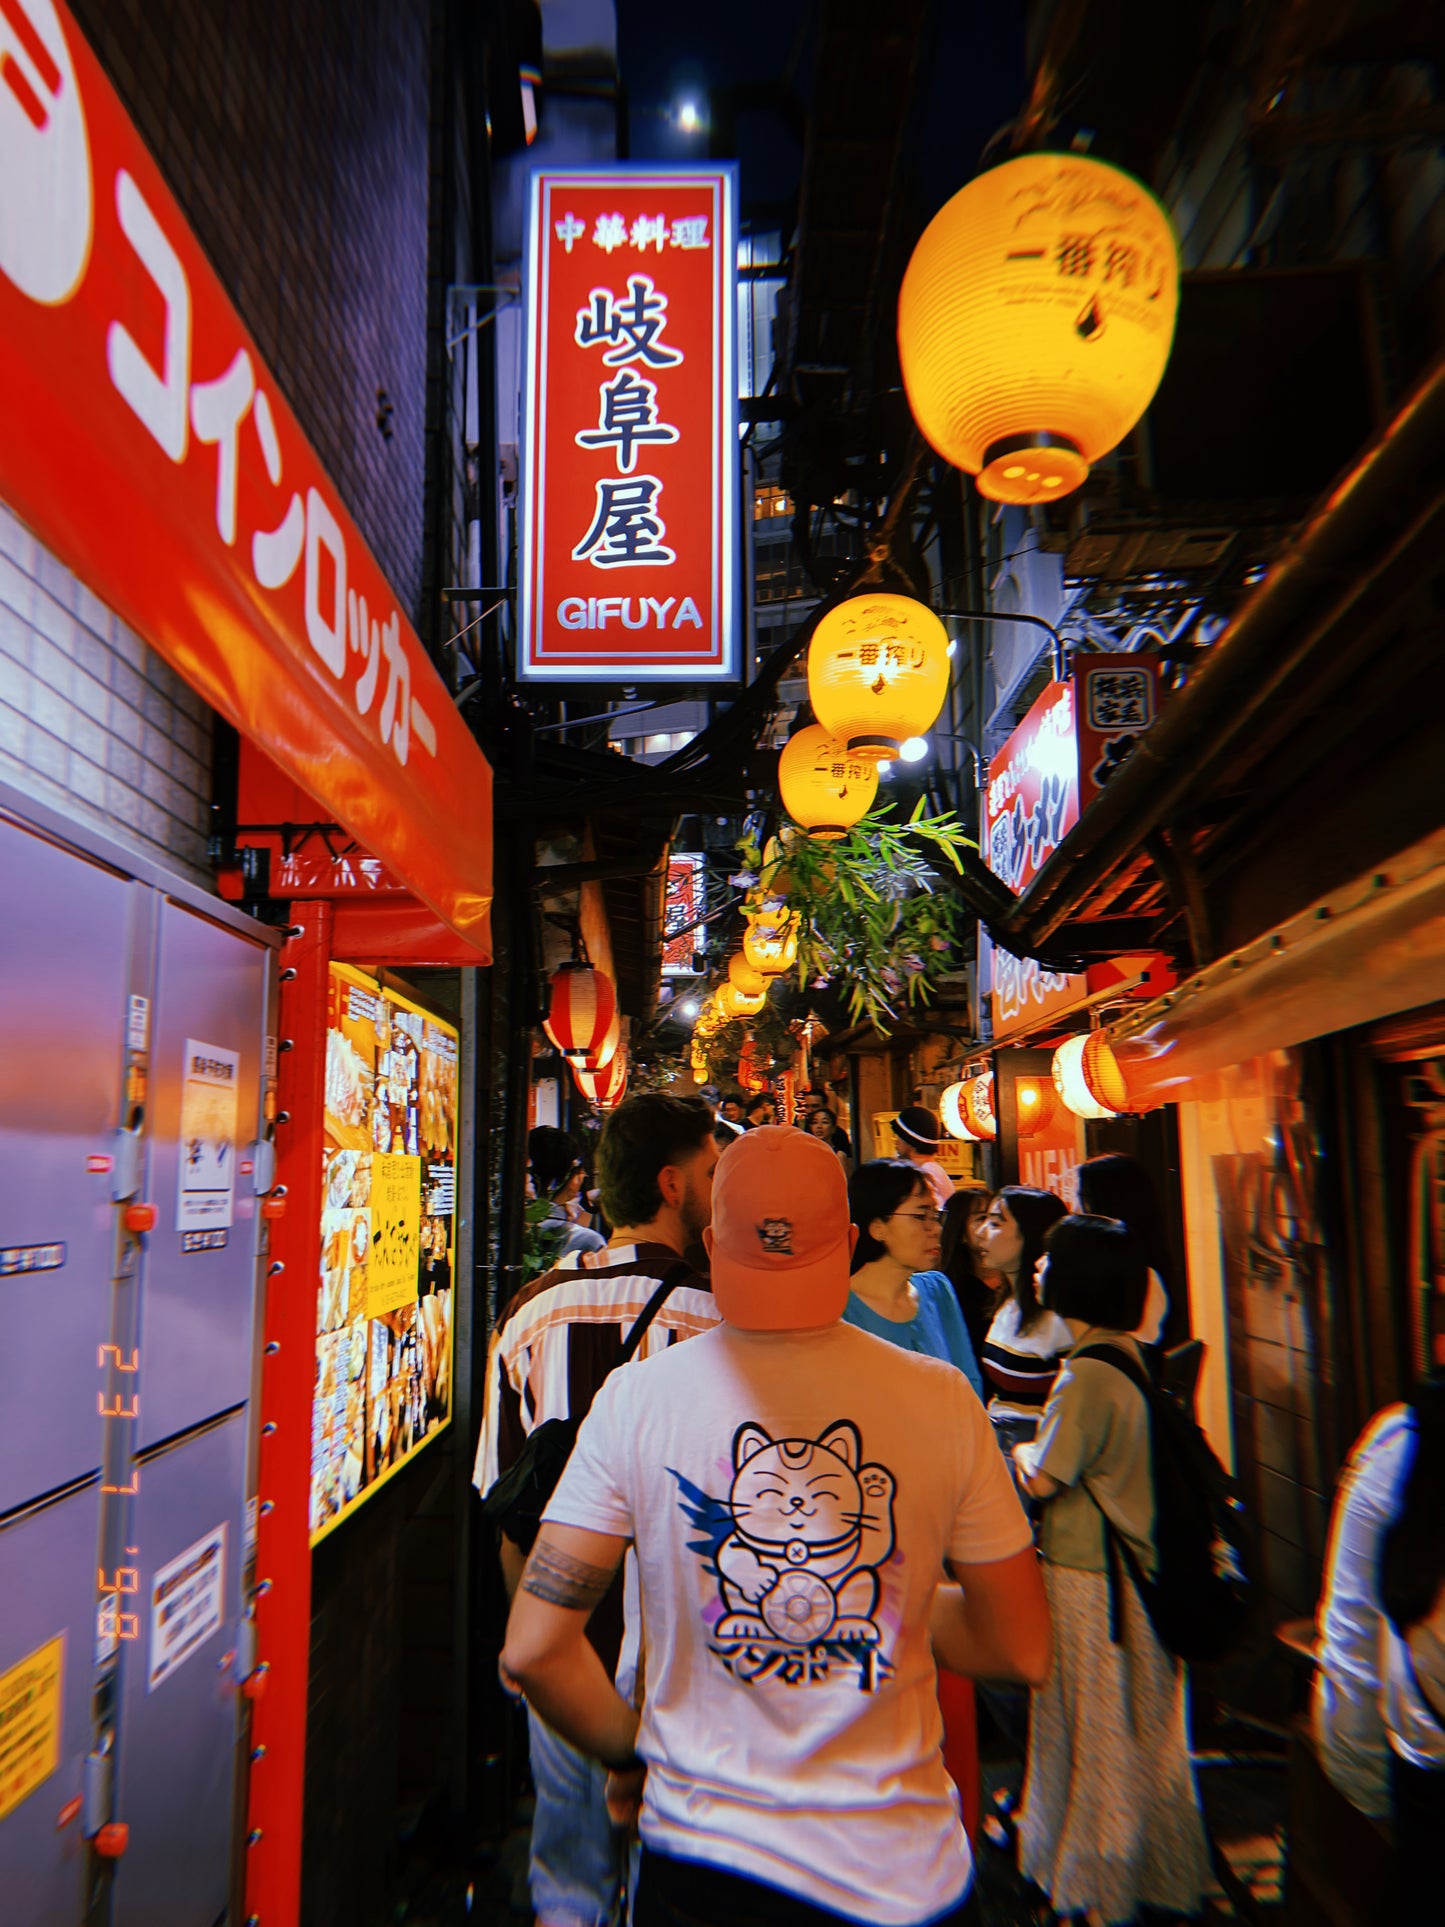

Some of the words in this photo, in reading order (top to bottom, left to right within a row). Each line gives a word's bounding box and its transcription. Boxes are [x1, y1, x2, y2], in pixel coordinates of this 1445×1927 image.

[555, 211, 711, 254] 中華料理
[1006, 232, 1166, 302] 一番搾り
[573, 274, 683, 568] 岐阜屋
[107, 168, 437, 767] コインロッカー
[556, 596, 703, 630] GIFUYA
[837, 643, 925, 668] 一番搾り
